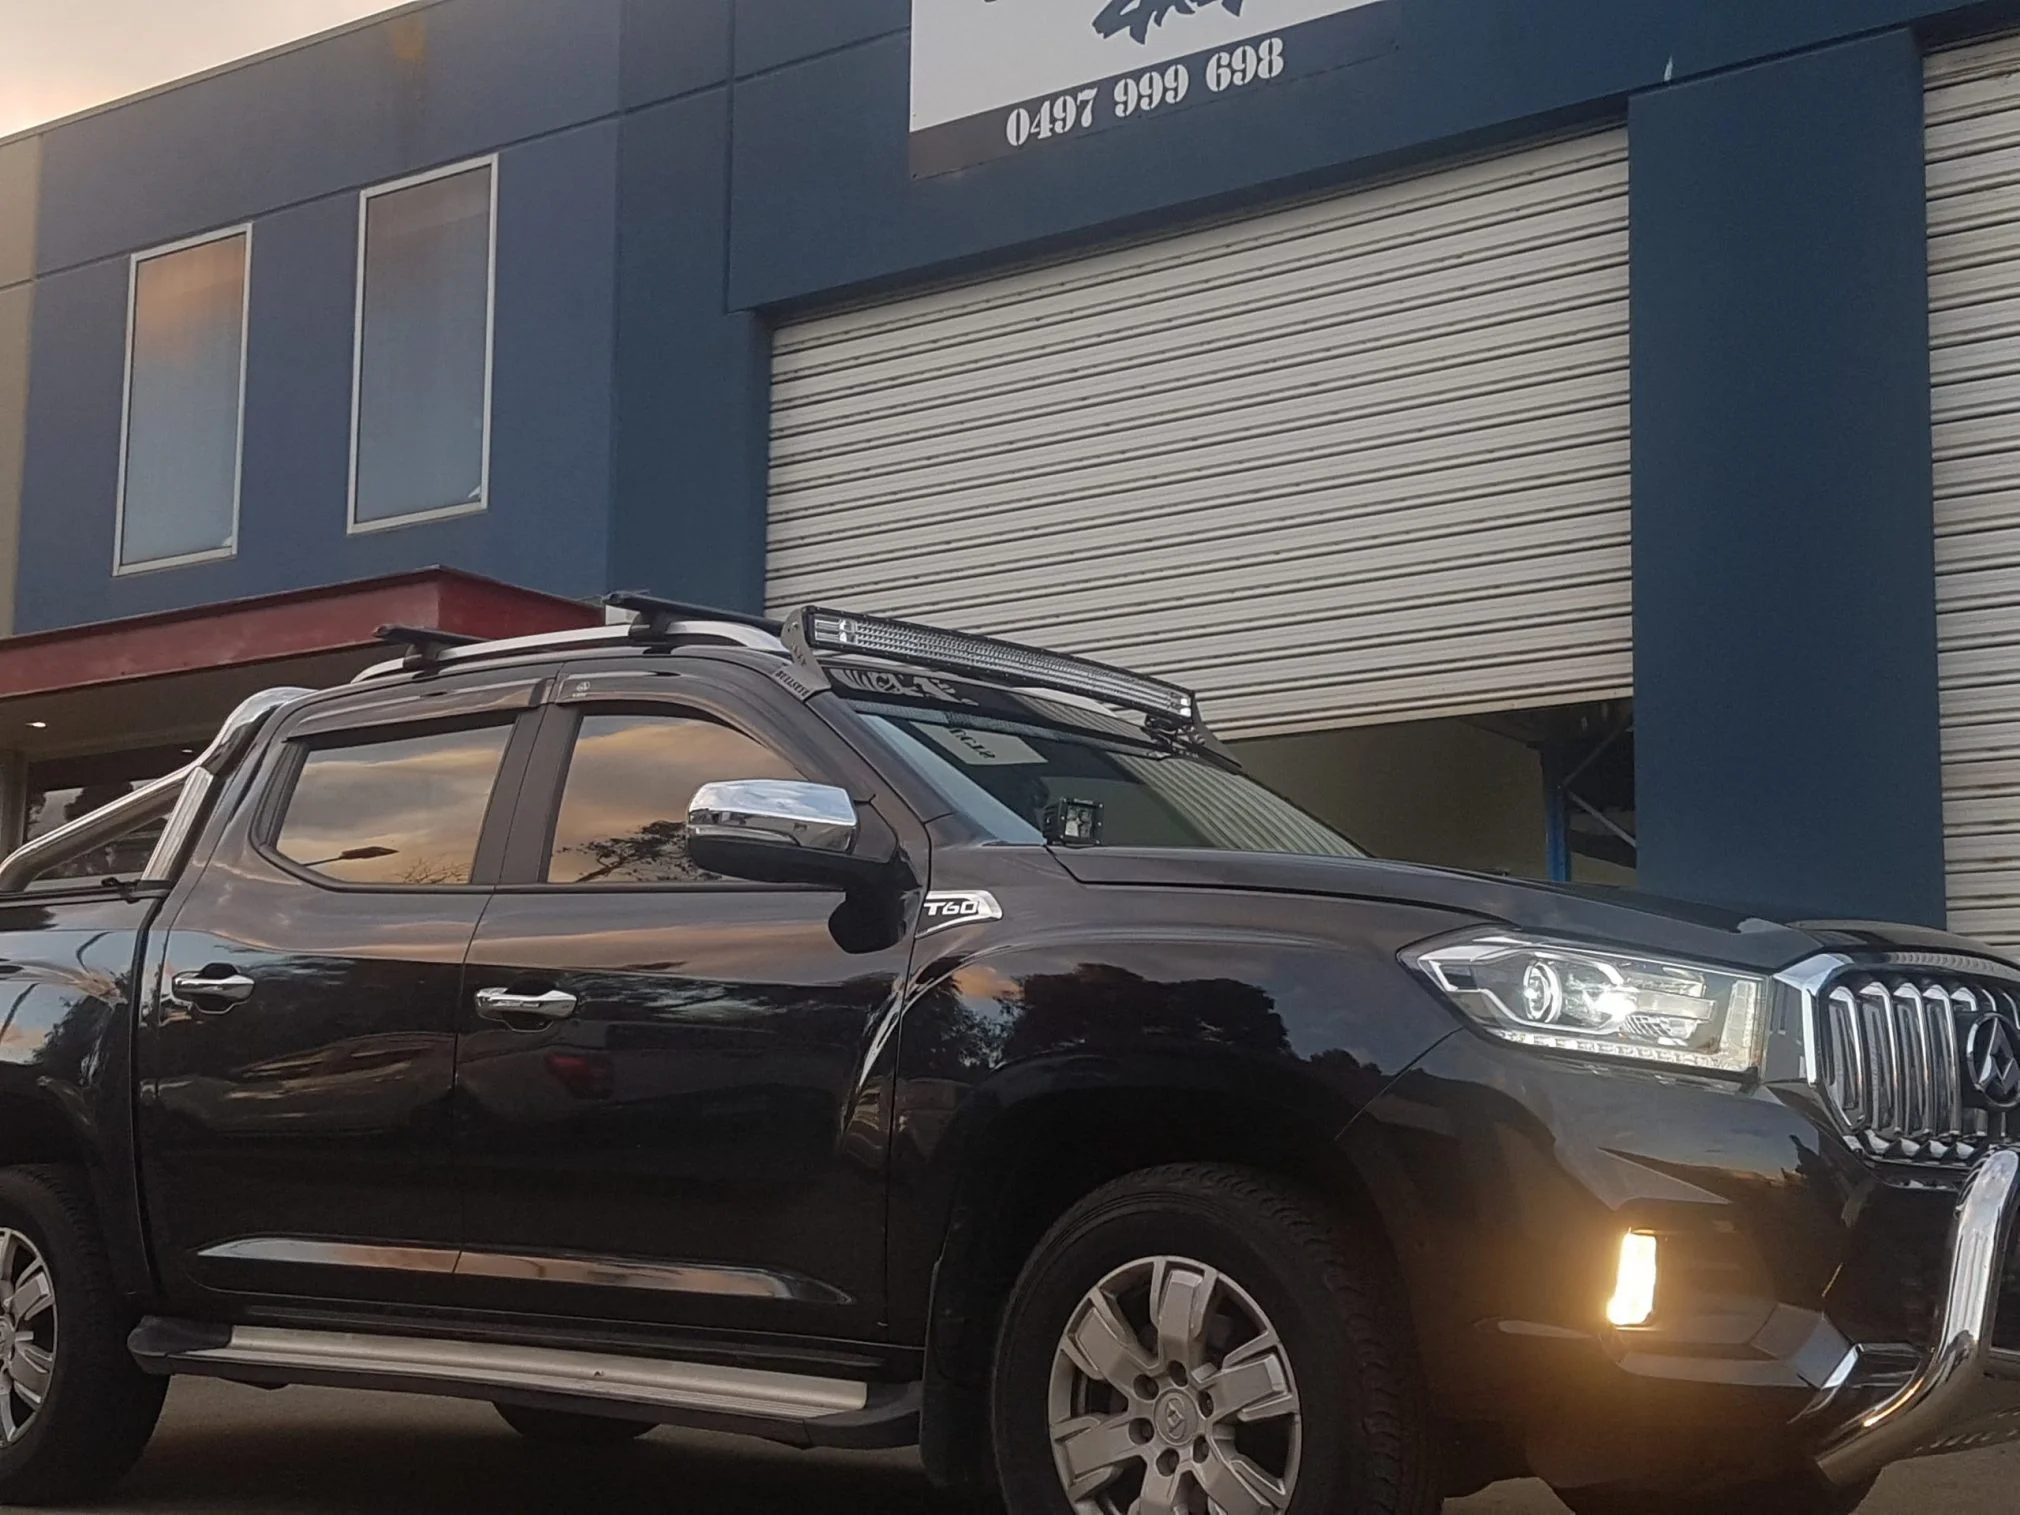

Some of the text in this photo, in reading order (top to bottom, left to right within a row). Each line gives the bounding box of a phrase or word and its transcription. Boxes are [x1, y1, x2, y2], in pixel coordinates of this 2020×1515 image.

[1006, 37, 1284, 147] 0497 999 698
[923, 900, 979, 917] T60
